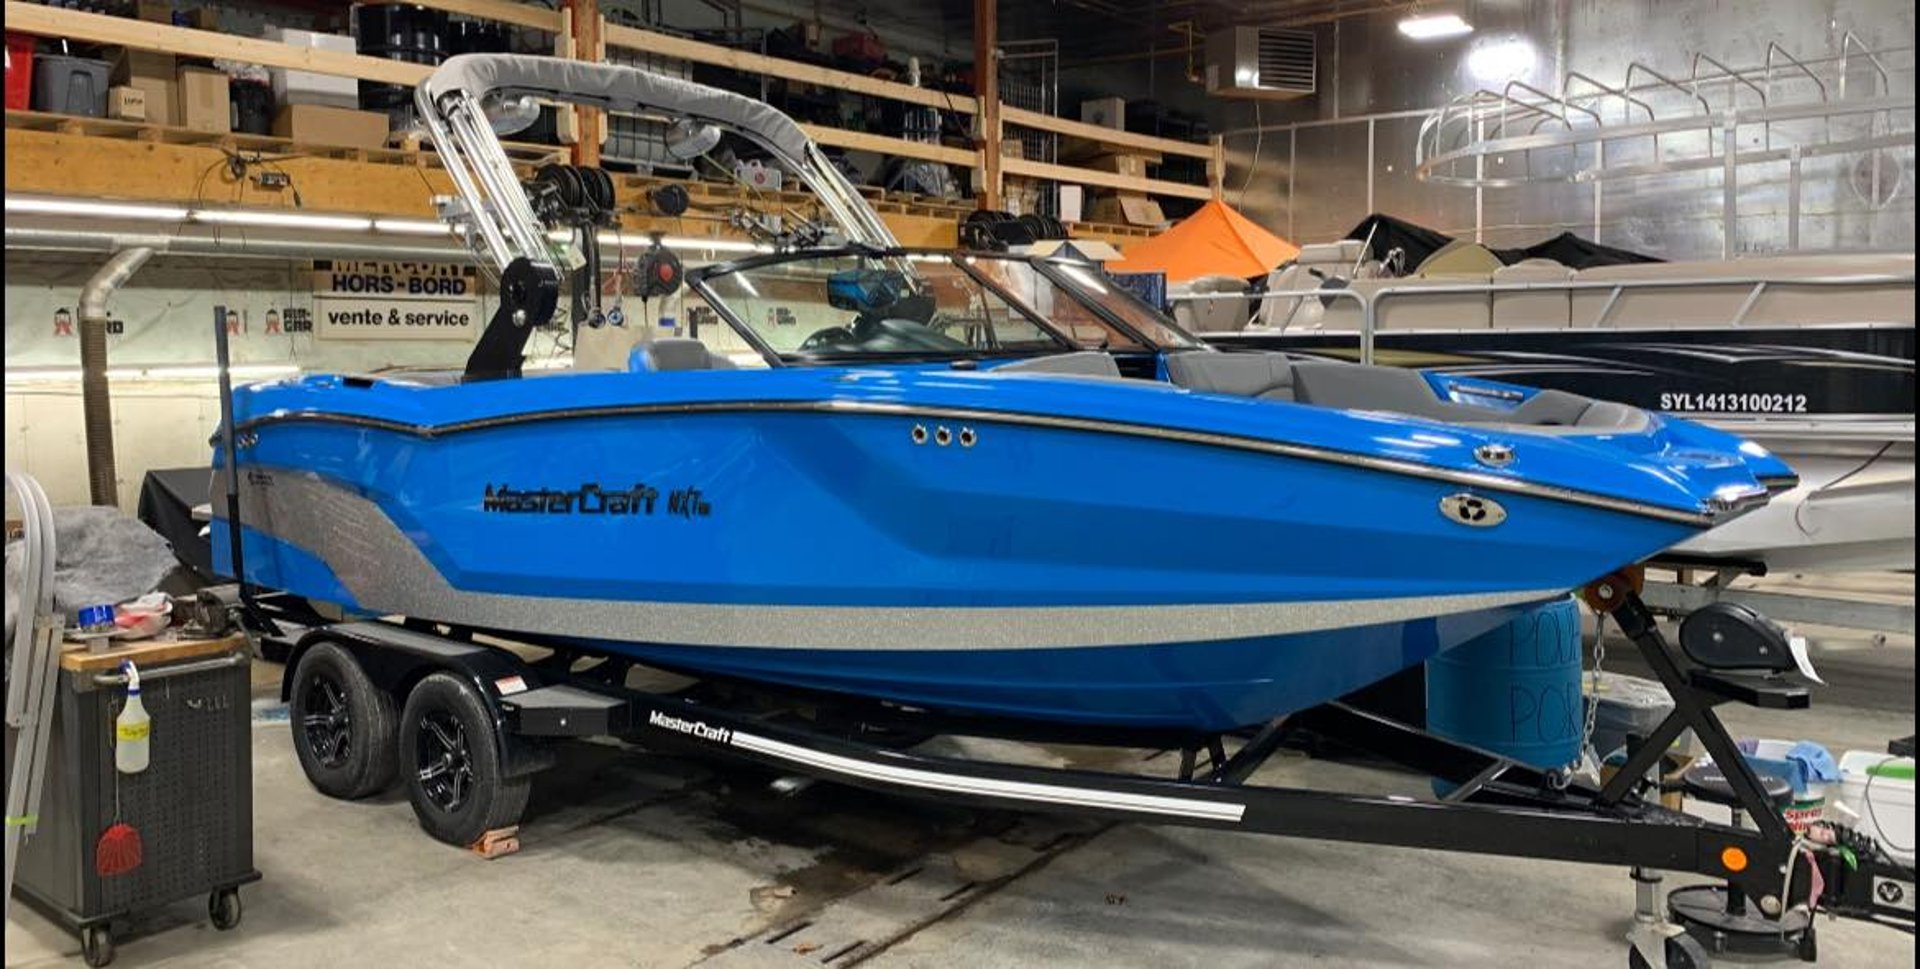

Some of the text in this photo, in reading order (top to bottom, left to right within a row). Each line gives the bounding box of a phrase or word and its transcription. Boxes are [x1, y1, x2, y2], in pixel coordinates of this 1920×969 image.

[283, 320, 313, 333] GAR
[328, 308, 469, 326] vente & service
[1660, 393, 1808, 412] SYL1413100212
[484, 482, 658, 515] MasterCraft
[649, 709, 731, 743] MasterCraft
